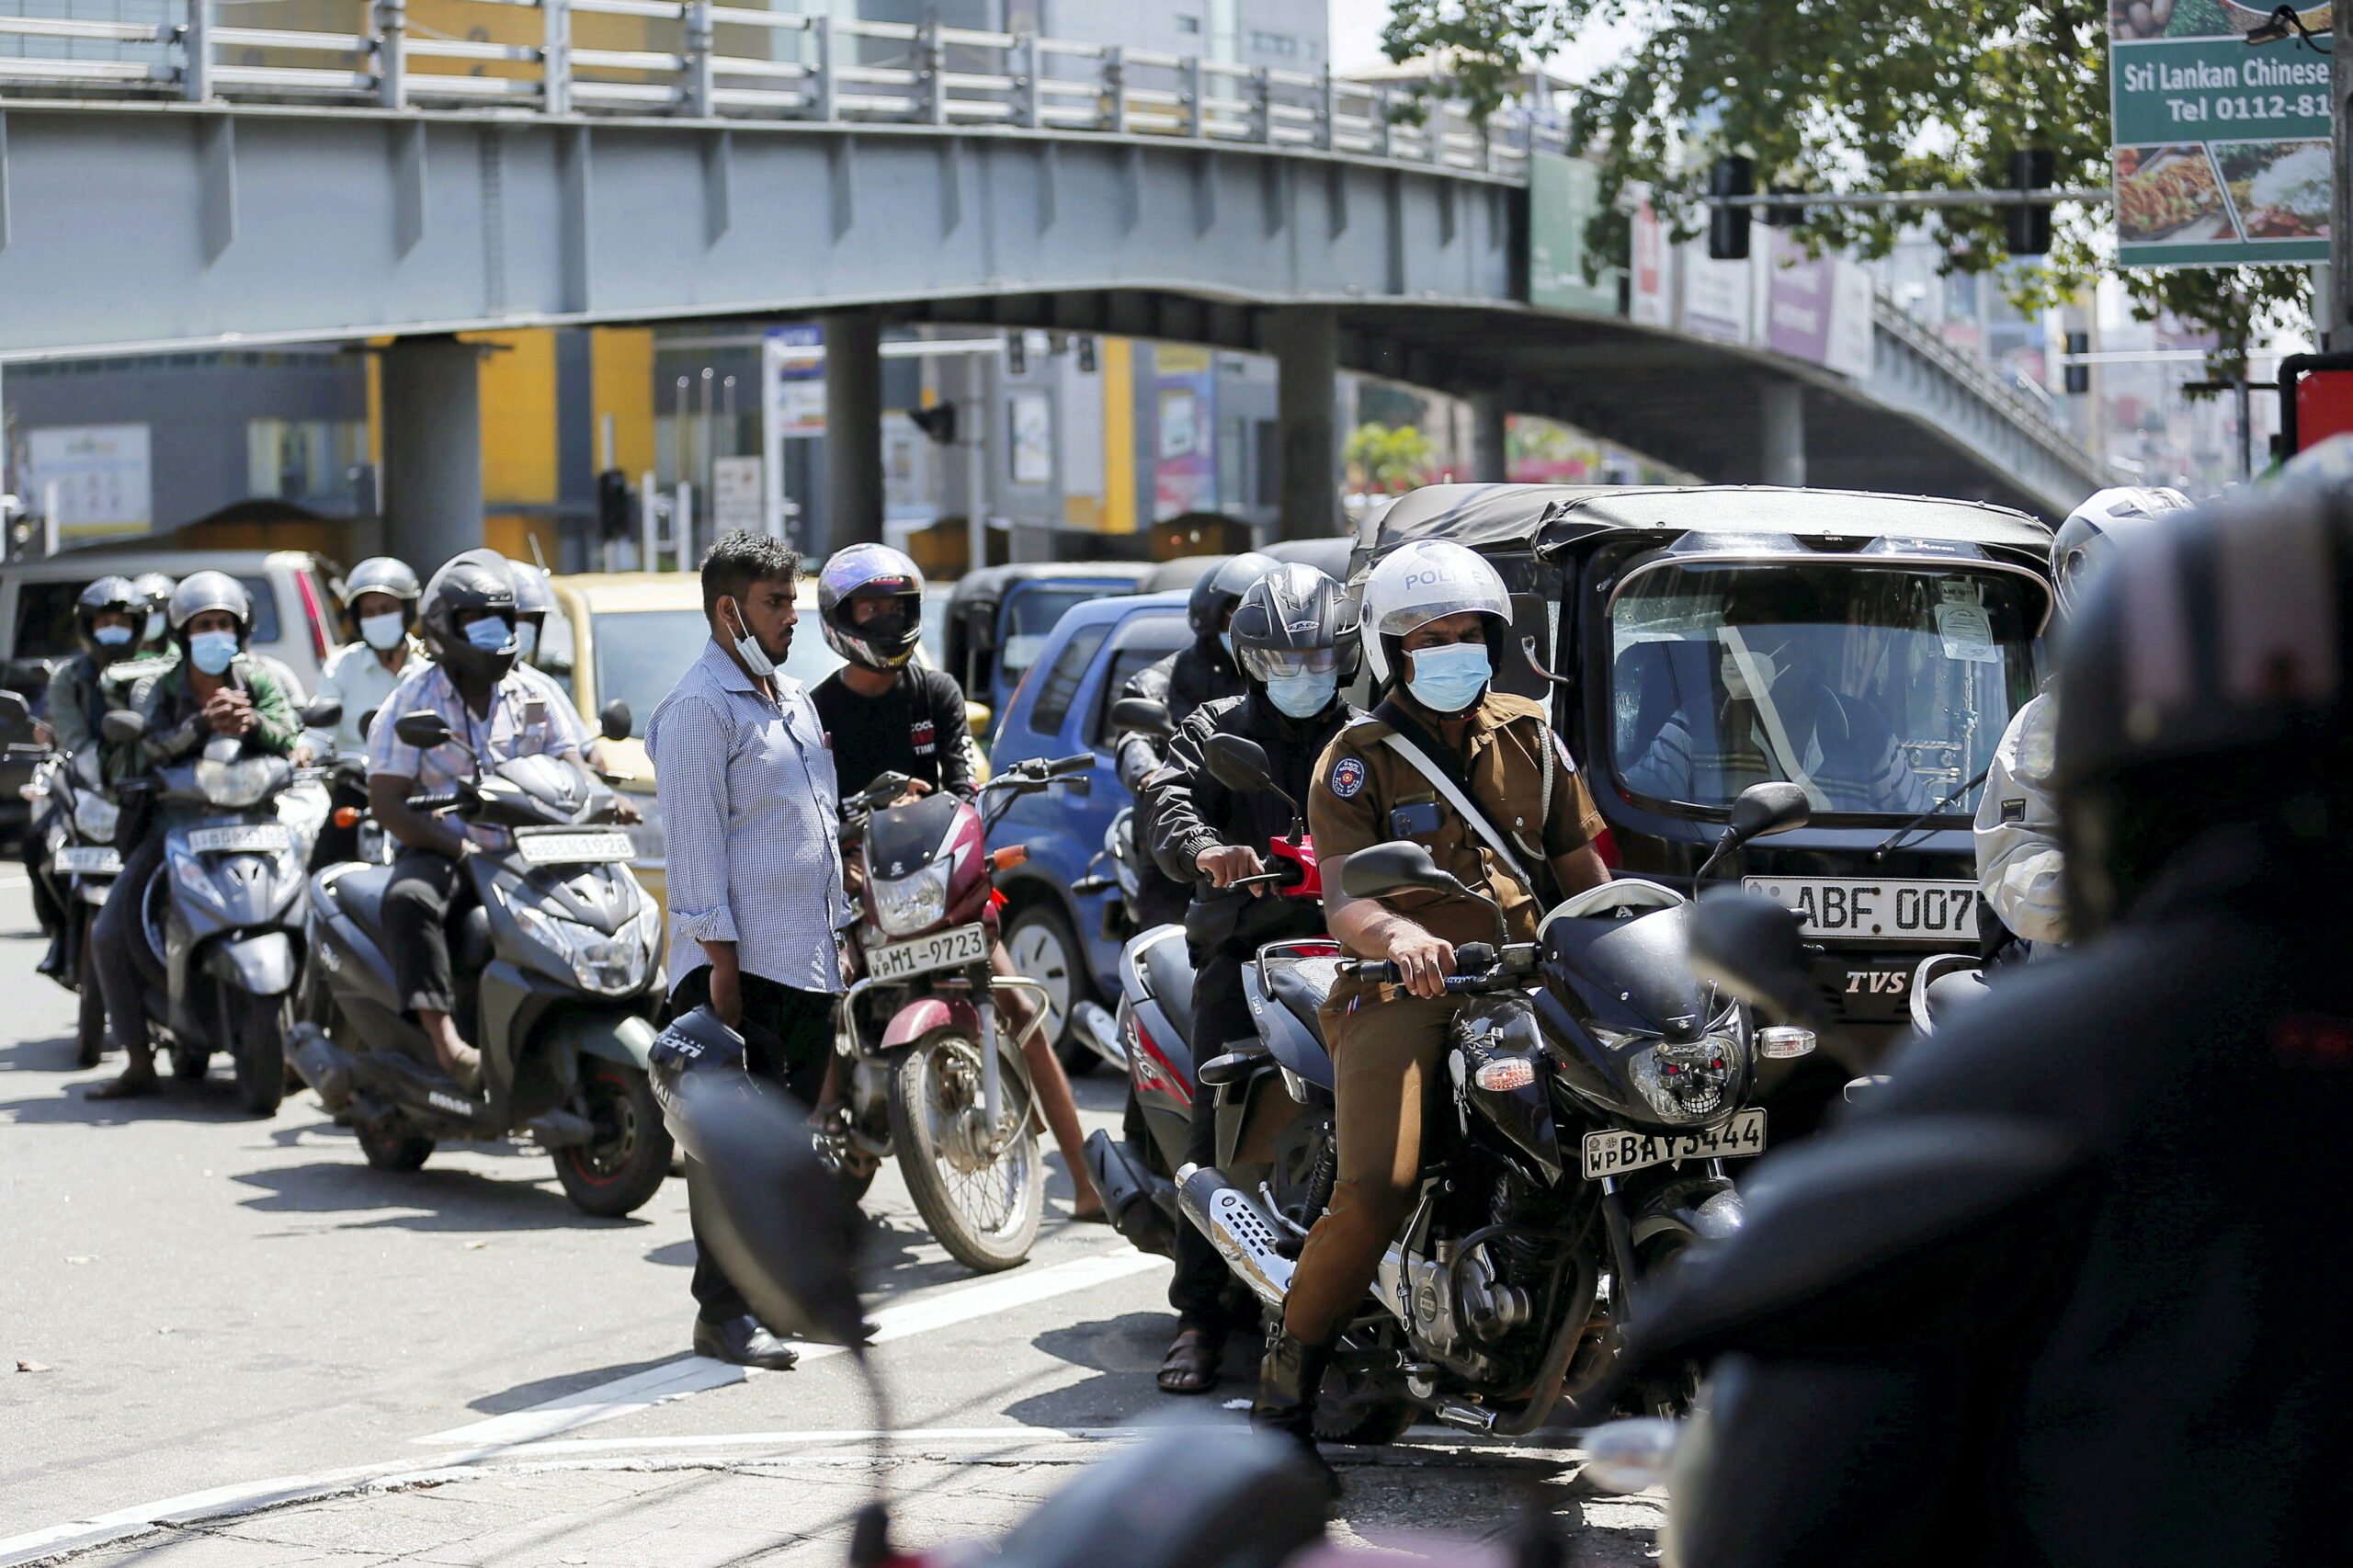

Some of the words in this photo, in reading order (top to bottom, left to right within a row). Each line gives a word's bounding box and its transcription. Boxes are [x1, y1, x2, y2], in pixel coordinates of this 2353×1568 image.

[2123, 62, 2155, 92] Sri
[2160, 59, 2238, 91] Lankan
[2243, 55, 2330, 87] Chinese
[2165, 97, 2208, 122] Tel
[1405, 567, 1485, 590] POLIE
[1799, 886, 1875, 929] ABF
[1895, 888, 1984, 931] 007
[1845, 971, 1907, 994] TVS
[1251, 995, 1263, 1016] 150
[1589, 1152, 1618, 1172] WP
